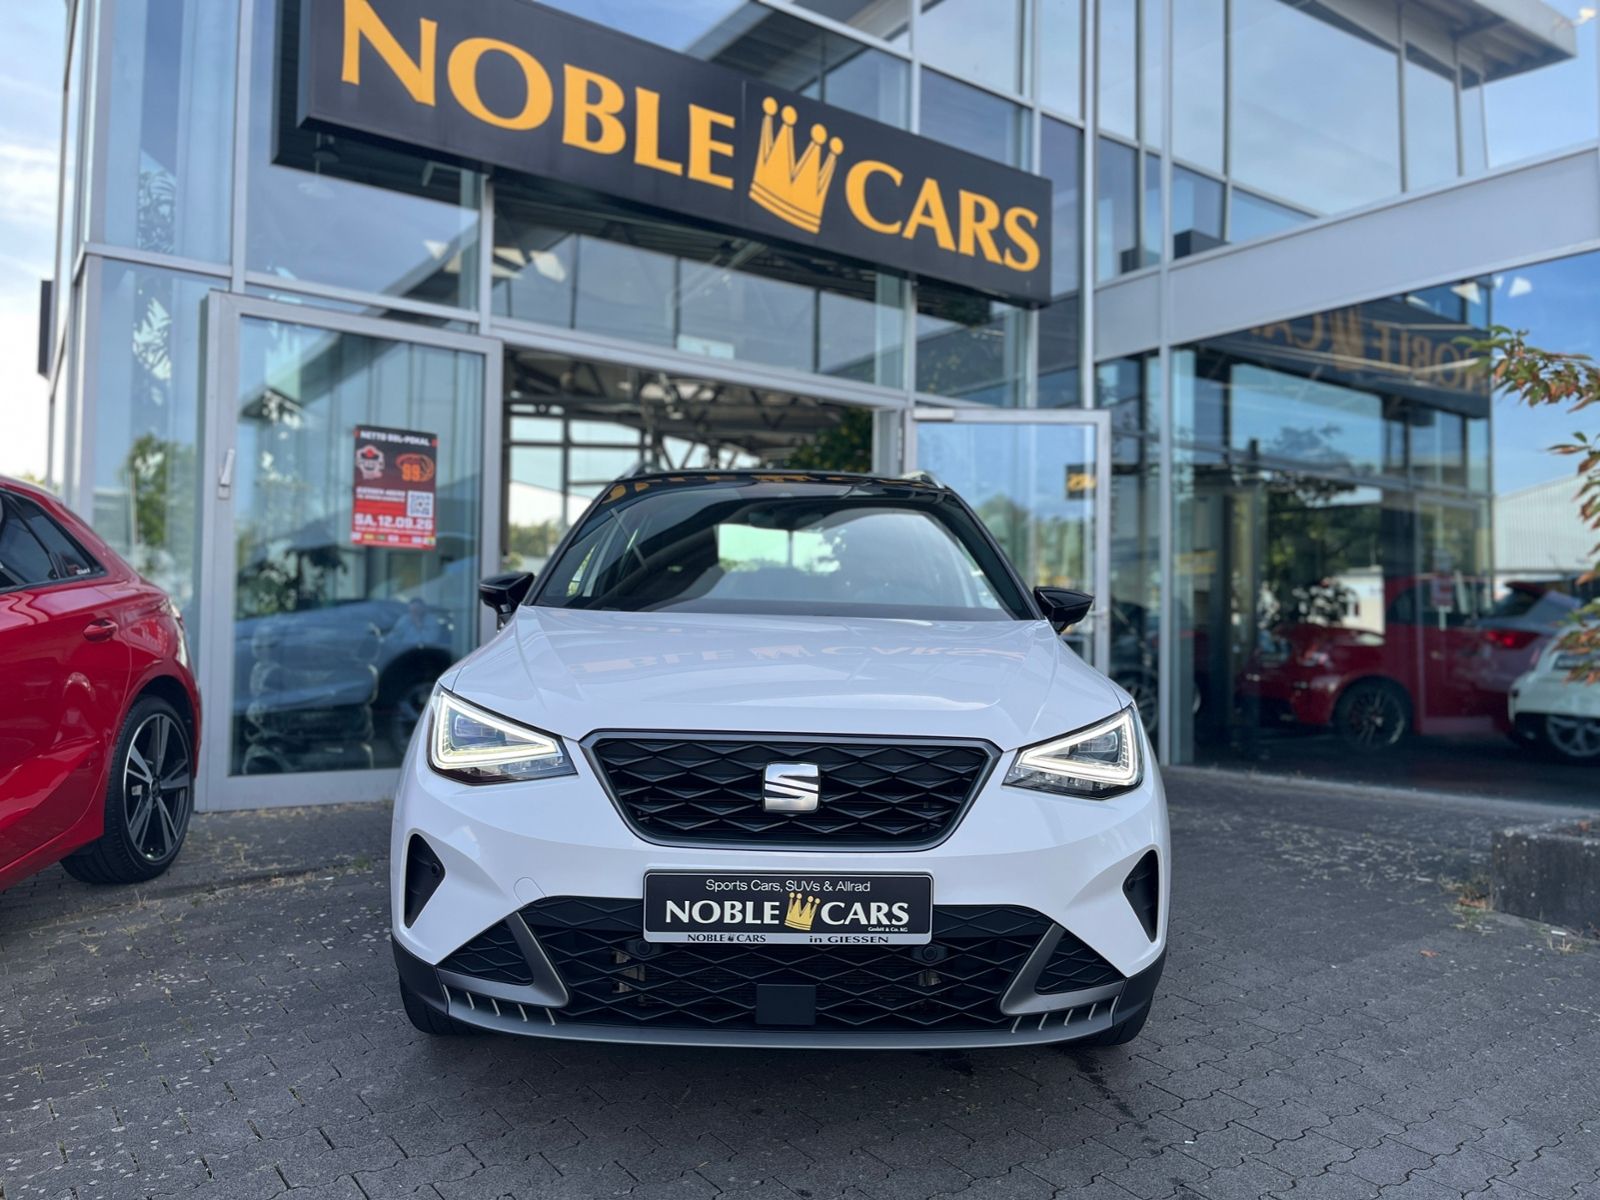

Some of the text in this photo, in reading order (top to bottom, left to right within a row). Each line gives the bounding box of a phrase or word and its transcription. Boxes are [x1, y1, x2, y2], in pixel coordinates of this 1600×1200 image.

[341, 0, 1041, 273] NOBLE CARS
[705, 879, 871, 892] Sports Cars, SUVs & Allrad
[665, 900, 910, 925] NOBLE CARS
[687, 934, 766, 943] NOBLE CARS
[809, 935, 889, 943] in GIESSEN
